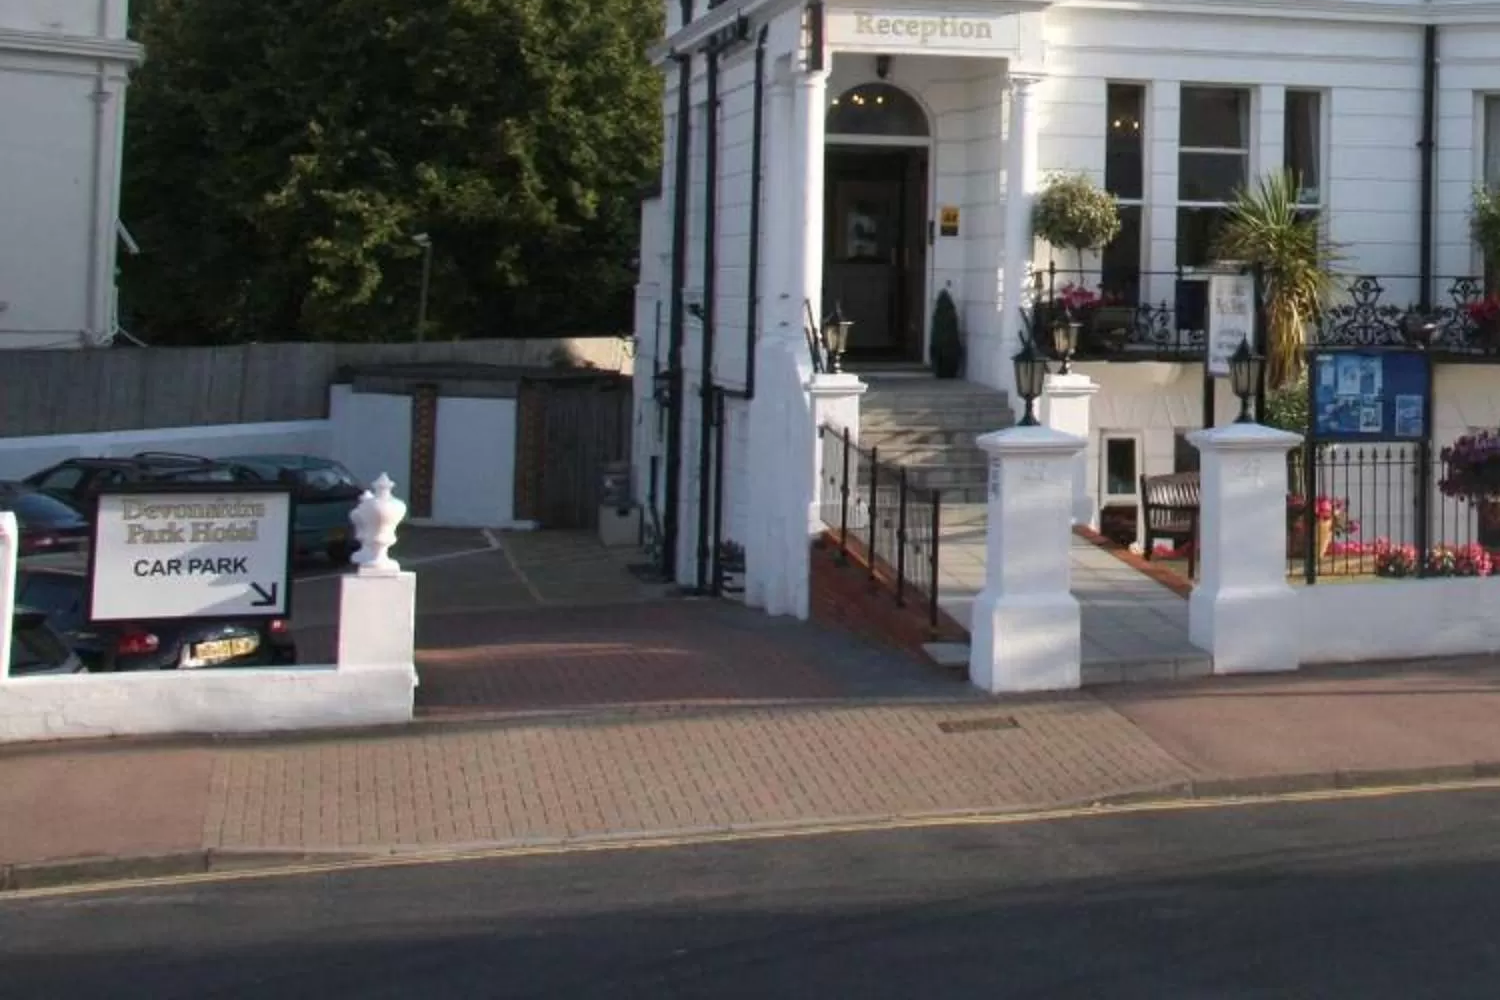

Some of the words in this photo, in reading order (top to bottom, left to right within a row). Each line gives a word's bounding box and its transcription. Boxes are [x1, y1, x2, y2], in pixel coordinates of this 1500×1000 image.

[853, 11, 993, 43] Reception
[126, 521, 185, 545] Park
[189, 520, 259, 543] Hotel
[134, 559, 181, 577] CAR
[188, 556, 248, 575] PARK
